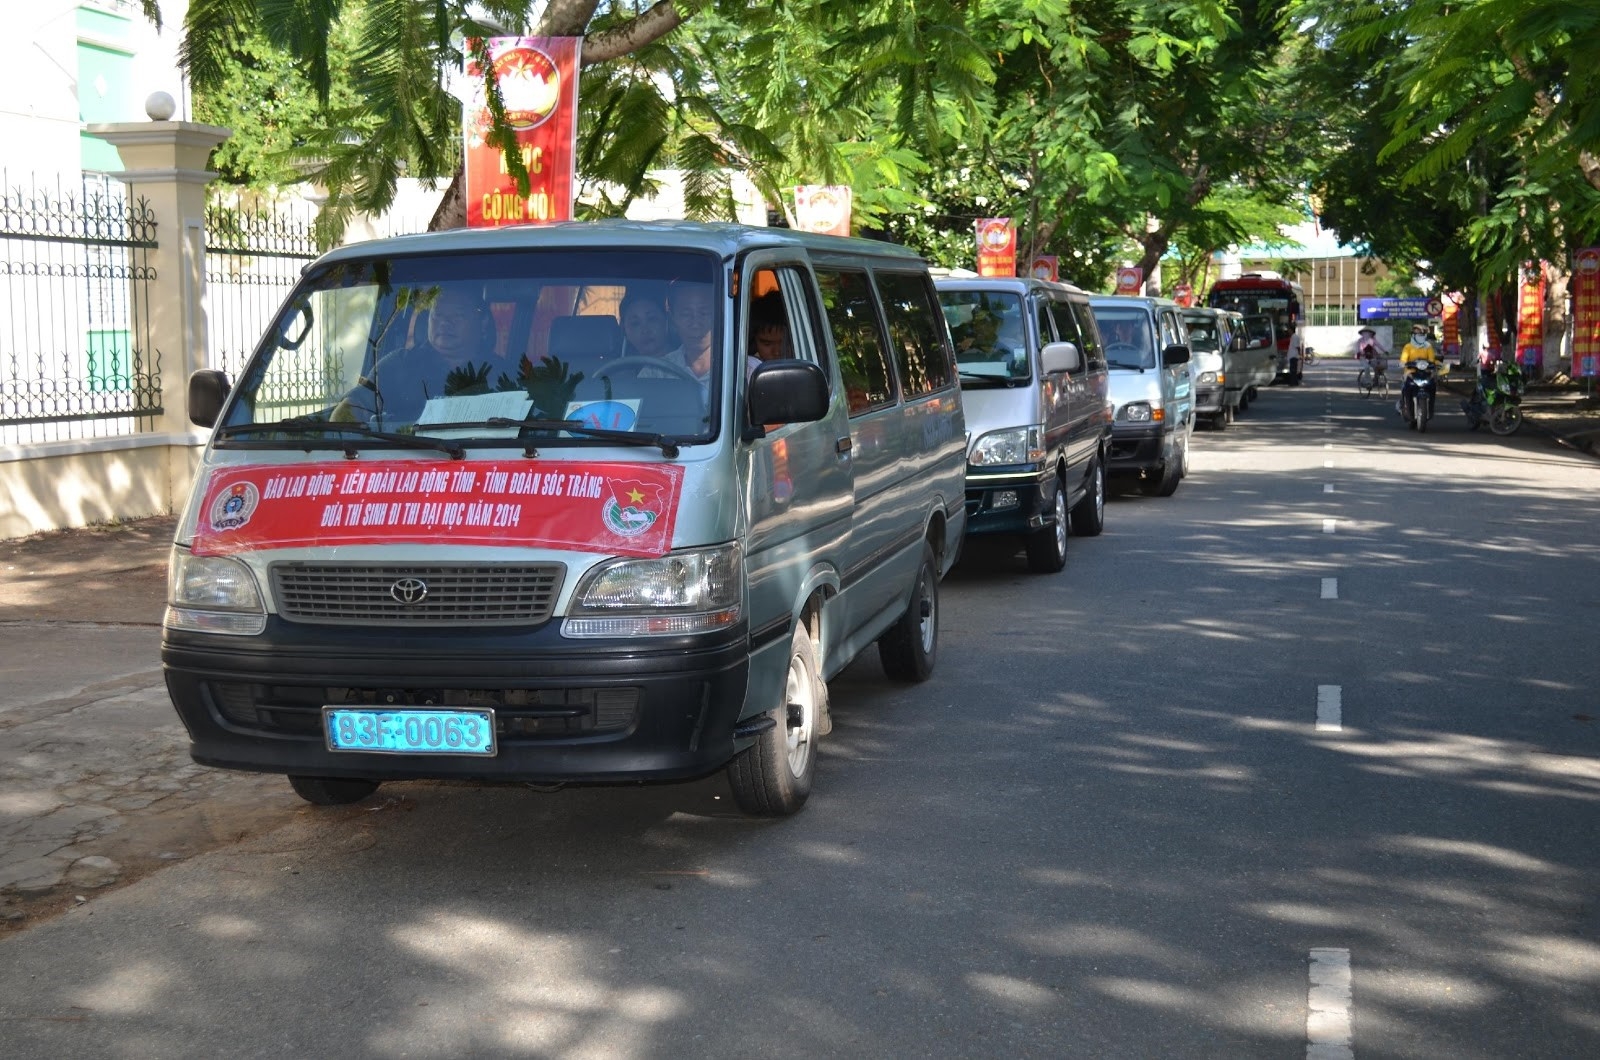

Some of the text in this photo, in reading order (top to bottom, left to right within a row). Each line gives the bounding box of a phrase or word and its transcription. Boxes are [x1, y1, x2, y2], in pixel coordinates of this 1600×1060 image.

[482, 187, 556, 225] CỘNG HÒA
[263, 474, 286, 499] BÁO
[285, 475, 307, 497] LAO
[306, 471, 336, 500] ĐỘNG
[340, 469, 367, 495] LIÊN
[366, 468, 398, 493] ĐOÀN
[396, 471, 419, 493] LAO
[419, 467, 449, 497] ĐỘNG
[450, 466, 476, 493] TỈNH
[483, 466, 509, 494] TỈNH
[509, 469, 541, 495] ĐOÀN
[541, 469, 565, 497] SÓC
[566, 472, 603, 499] TRĂNG
[320, 499, 522, 530] ĐƯA THÍ SINH ĐI THI ĐẠI HỌC NĂM 2014
